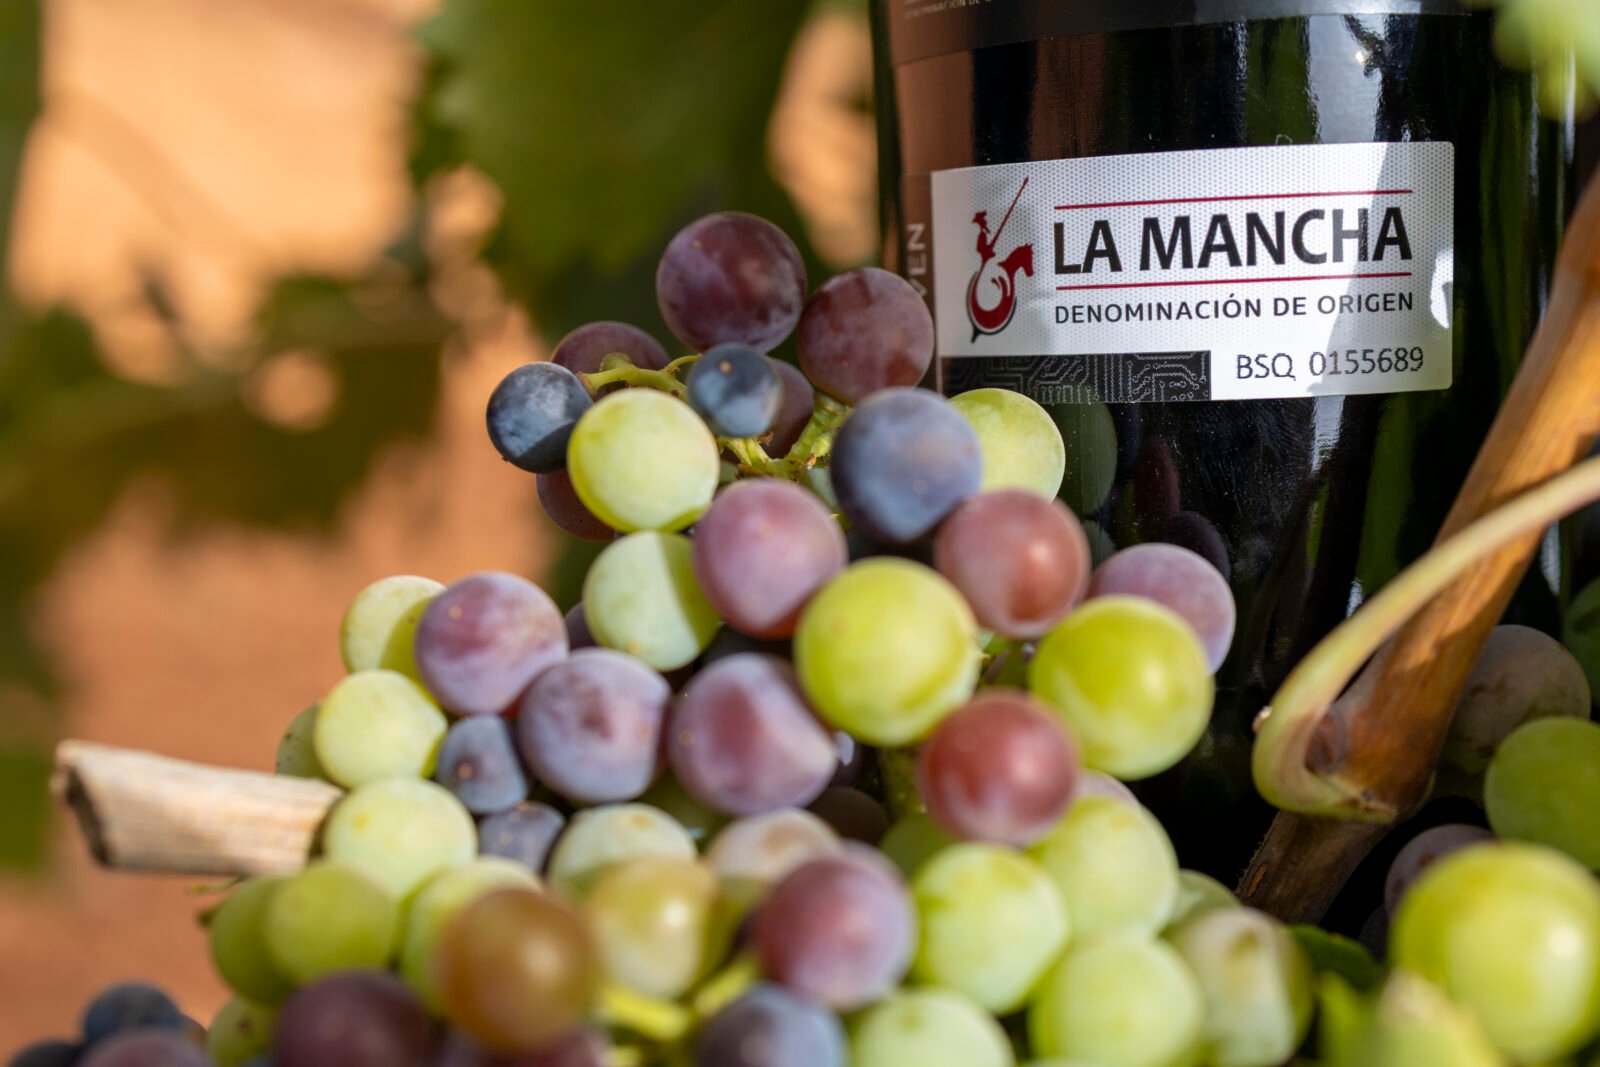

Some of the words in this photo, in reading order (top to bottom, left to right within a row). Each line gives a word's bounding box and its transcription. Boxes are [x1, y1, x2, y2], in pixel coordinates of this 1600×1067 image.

[1054, 220, 1123, 274] LA
[1139, 206, 1412, 271] MANCHA
[1055, 294, 1262, 324] DENOMINACIÓN
[1273, 297, 1307, 317] DE
[1317, 292, 1413, 315] ORIGEN
[1236, 352, 1297, 381] BSQ
[1308, 347, 1424, 376] 0155689
